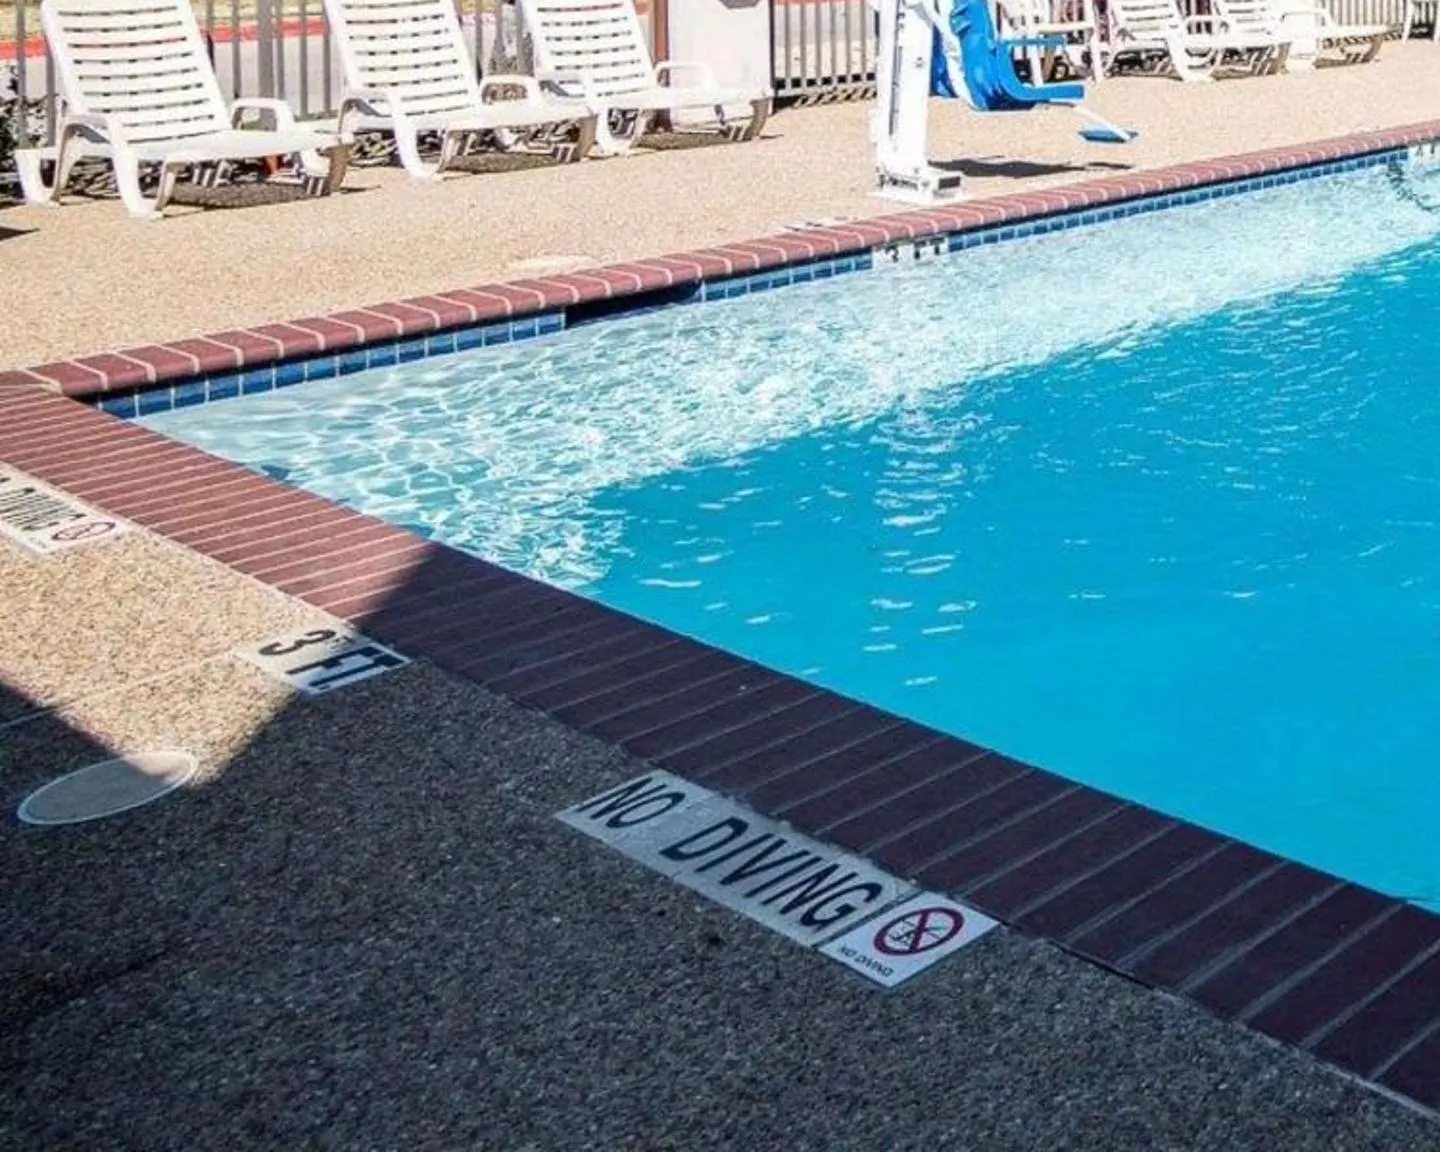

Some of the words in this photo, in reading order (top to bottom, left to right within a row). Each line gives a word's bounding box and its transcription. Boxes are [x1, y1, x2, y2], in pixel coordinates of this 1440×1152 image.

[258, 629, 337, 656] 3
[285, 646, 404, 687] FT
[576, 776, 686, 830] NO
[658, 816, 884, 931] DIVING
